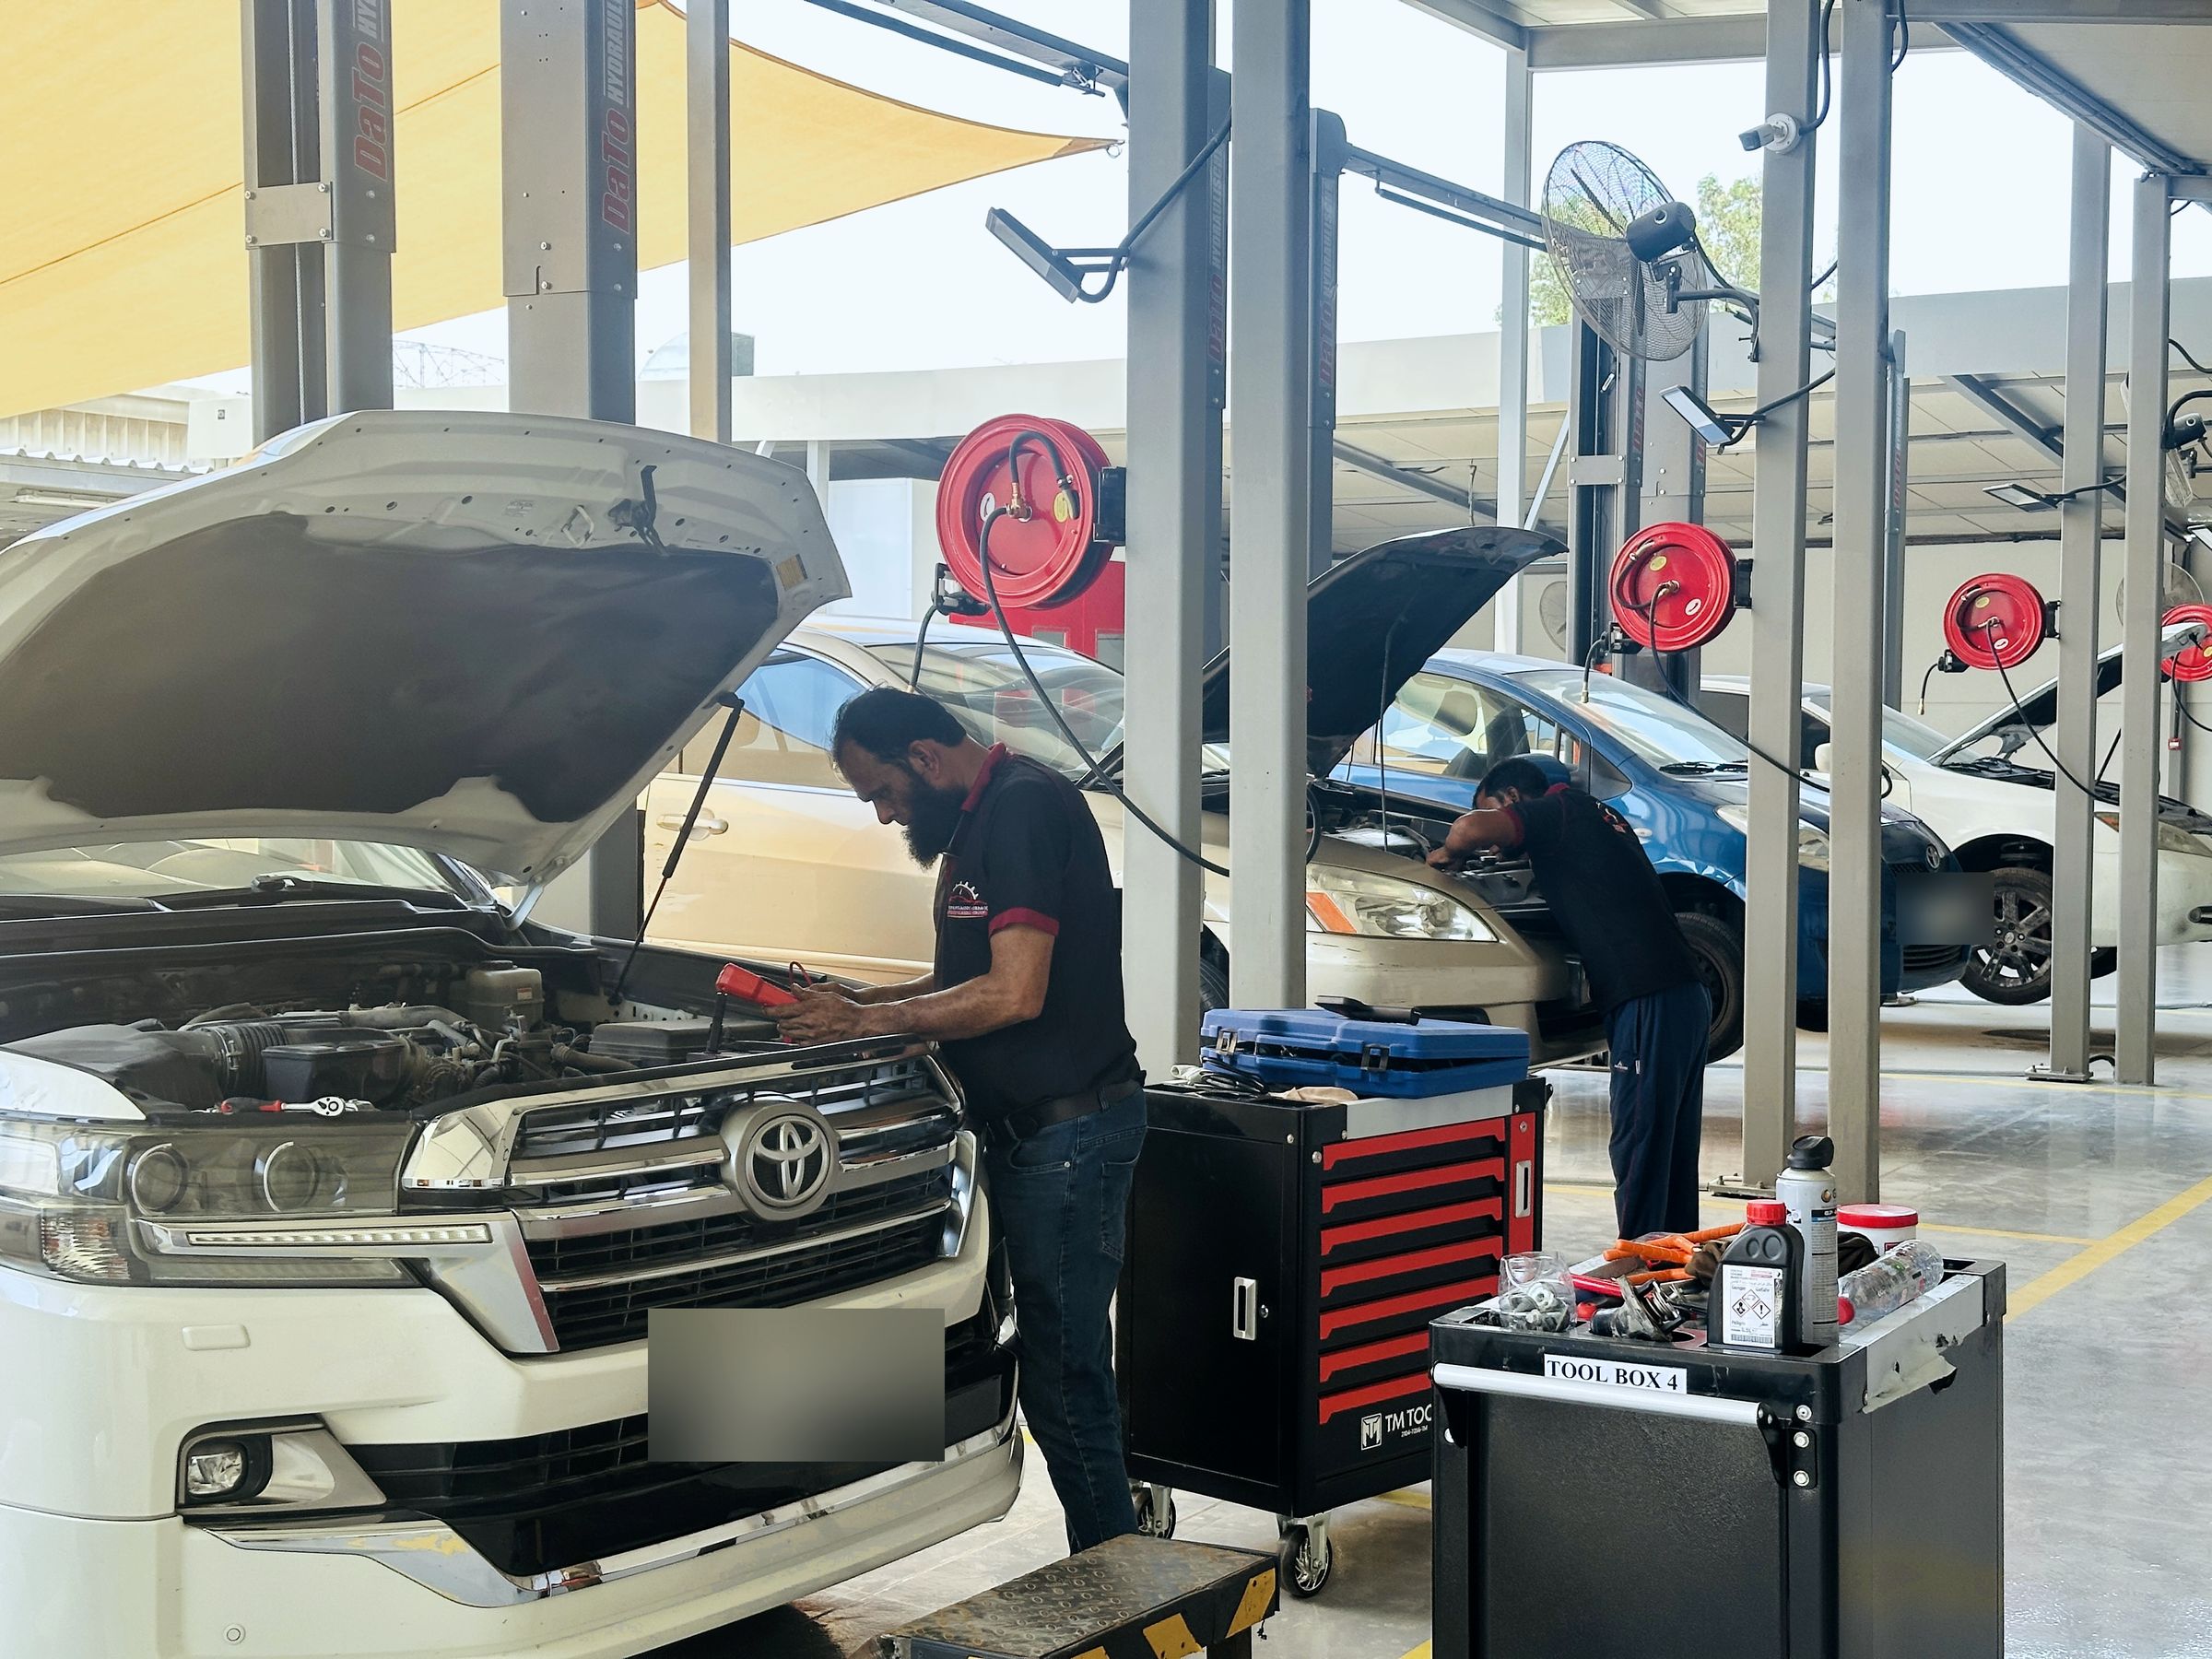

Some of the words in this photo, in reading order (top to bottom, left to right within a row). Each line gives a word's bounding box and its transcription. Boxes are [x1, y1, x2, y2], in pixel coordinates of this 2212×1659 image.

[357, 0, 378, 39] HY
[352, 41, 388, 182] DaTo
[601, 107, 630, 234] DaTo
[1547, 1359, 1608, 1382] TOOL
[1615, 1368, 1661, 1389] BOX
[1666, 1373, 1678, 1391] 4
[1385, 1411, 1405, 1432] TM
